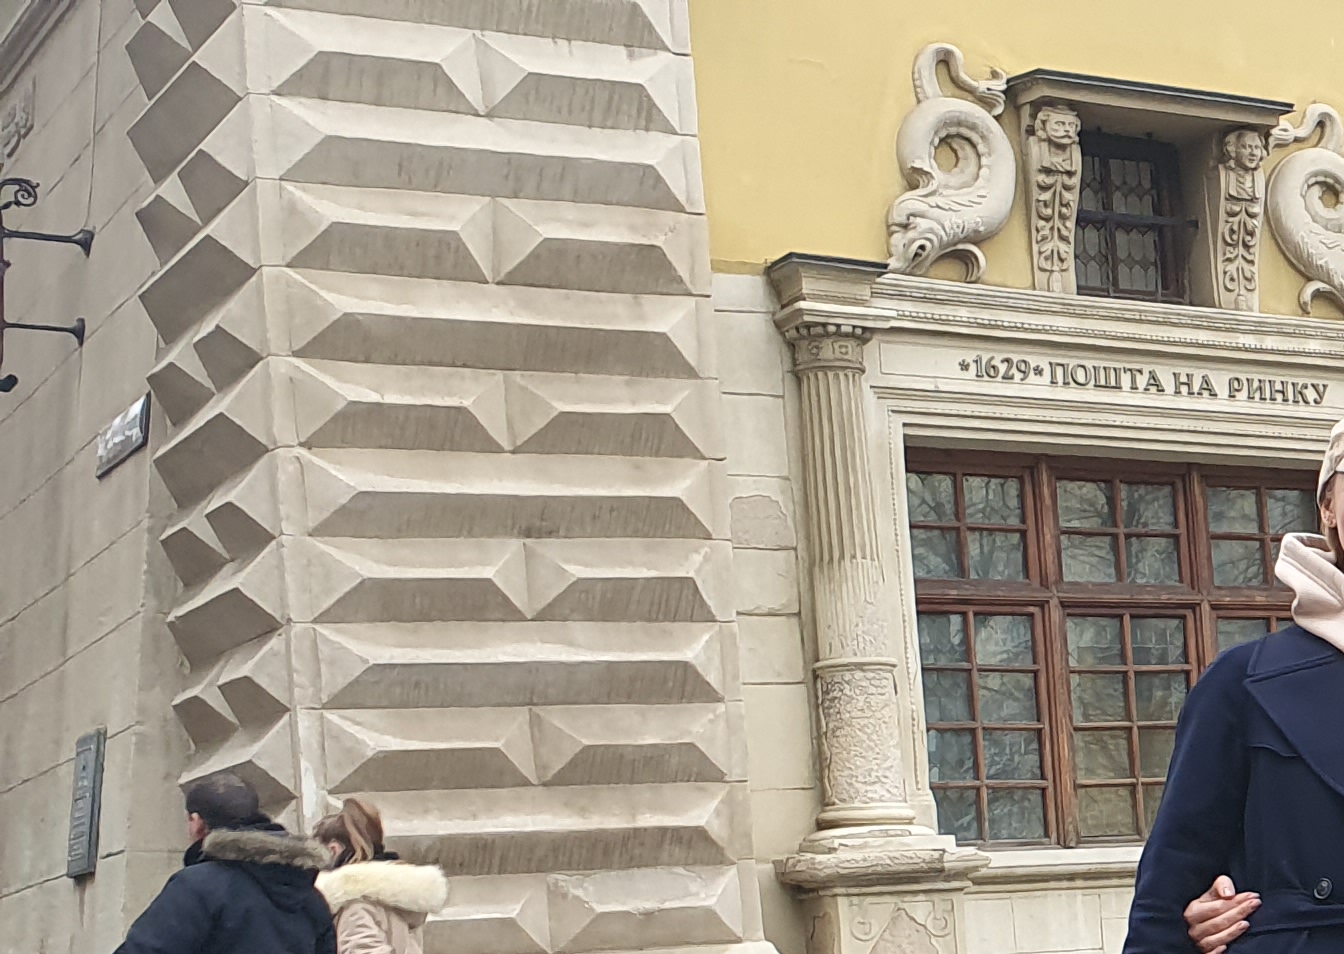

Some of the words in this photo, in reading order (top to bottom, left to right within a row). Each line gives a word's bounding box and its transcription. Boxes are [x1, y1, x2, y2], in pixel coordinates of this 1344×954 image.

[1048, 360, 1166, 393] ПОШТА
[1173, 371, 1218, 398] НА
[1227, 376, 1329, 406] РИНКУ
